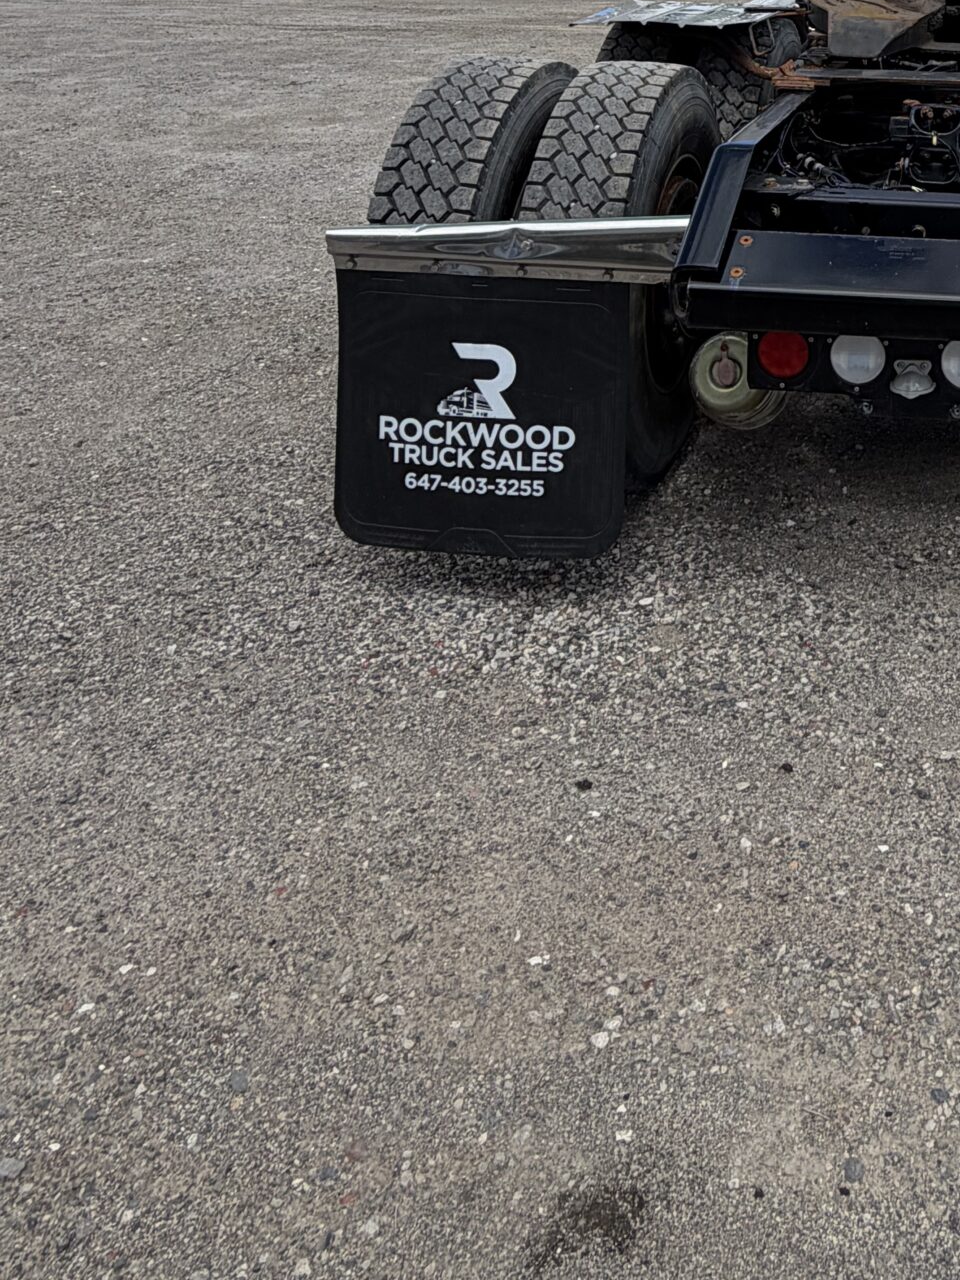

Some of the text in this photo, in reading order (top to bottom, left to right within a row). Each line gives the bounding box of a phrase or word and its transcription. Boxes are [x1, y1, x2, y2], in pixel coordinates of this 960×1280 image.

[451, 342, 517, 420] R
[379, 415, 576, 451] ROCKWOOD
[388, 442, 564, 473] TRUCK SALES
[404, 472, 545, 497] 647-403-3255
